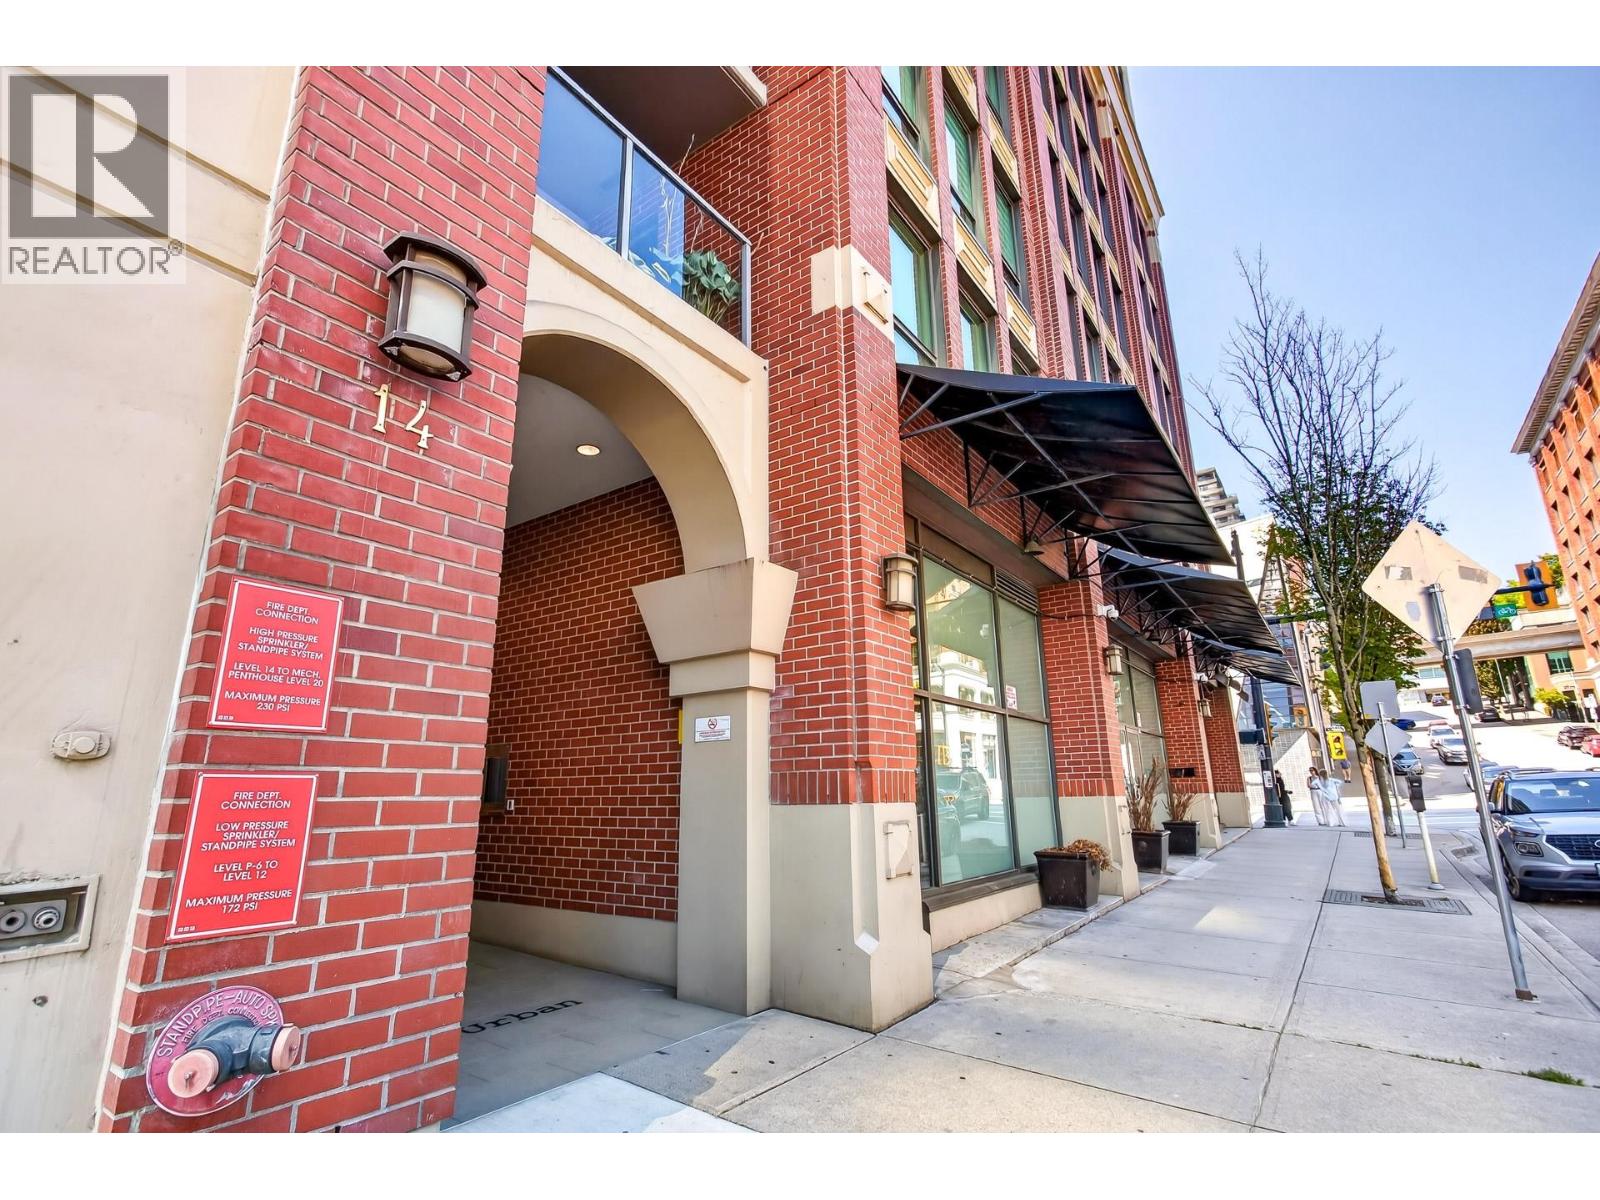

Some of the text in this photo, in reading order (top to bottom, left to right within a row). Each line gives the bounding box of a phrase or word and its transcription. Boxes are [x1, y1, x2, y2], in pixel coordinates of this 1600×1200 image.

[372, 383, 434, 449] 14
[267, 601, 285, 611] FIRE
[256, 609, 319, 624] CONNECTION
[250, 627, 318, 643] HIGH PRESSURE
[258, 637, 309, 650] SPRINKLER/
[238, 643, 323, 661] STANDPIPE SYSTEM
[234, 662, 320, 679] LEVEL 14 TO MECH.
[228, 671, 284, 683] PENTHOUSE
[287, 677, 311, 686] LEVEL
[225, 691, 321, 706] MAXIMUM PRESSURE
[277, 704, 290, 712] PSI
[234, 791, 282, 800] FIRE DEPT.
[221, 800, 291, 810] CONNECTION
[216, 821, 289, 832] LOW PRESSURE
[223, 830, 280, 841] SPRINKLER/
[201, 839, 296, 851] STANDPIPE SYSTEM
[214, 860, 278, 873] LEVEL P-6 TO
[223, 871, 267, 882] LEVEL 12
[185, 889, 292, 908] MAXIMUM PRESSURE
[222, 902, 258, 914] 172 PSI
